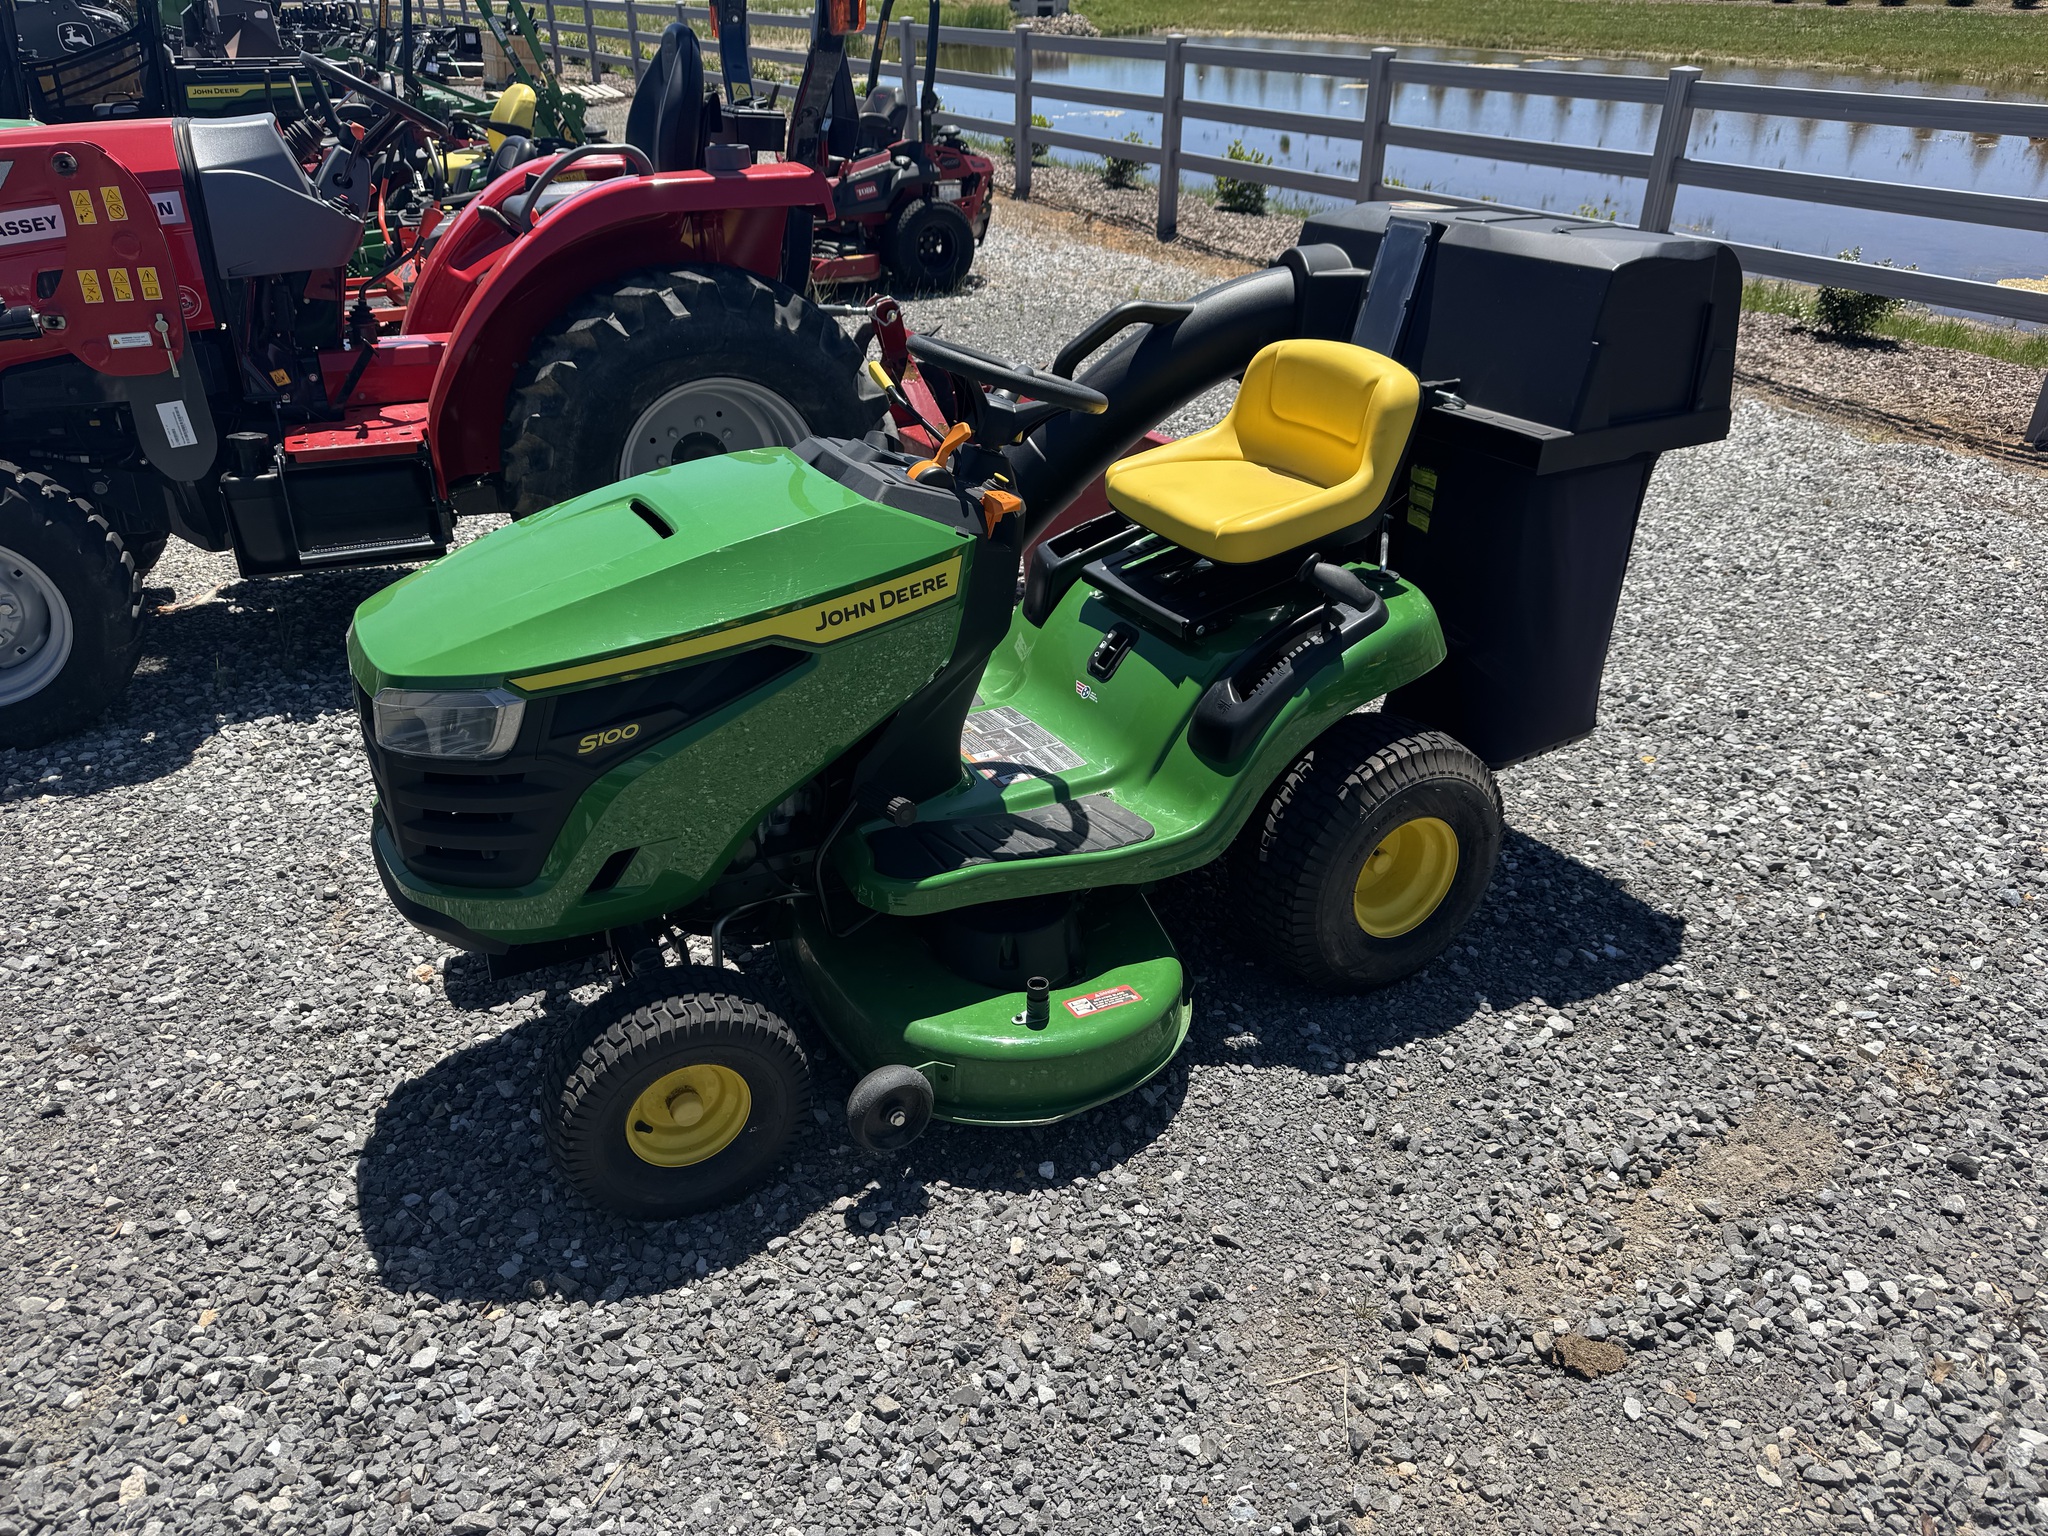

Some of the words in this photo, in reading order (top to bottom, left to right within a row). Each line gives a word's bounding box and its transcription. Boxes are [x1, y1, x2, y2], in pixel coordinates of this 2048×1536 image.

[857, 185, 877, 197] TORO
[815, 598, 876, 632] JOHN
[879, 572, 949, 610] DEERE
[577, 723, 640, 754] S100
